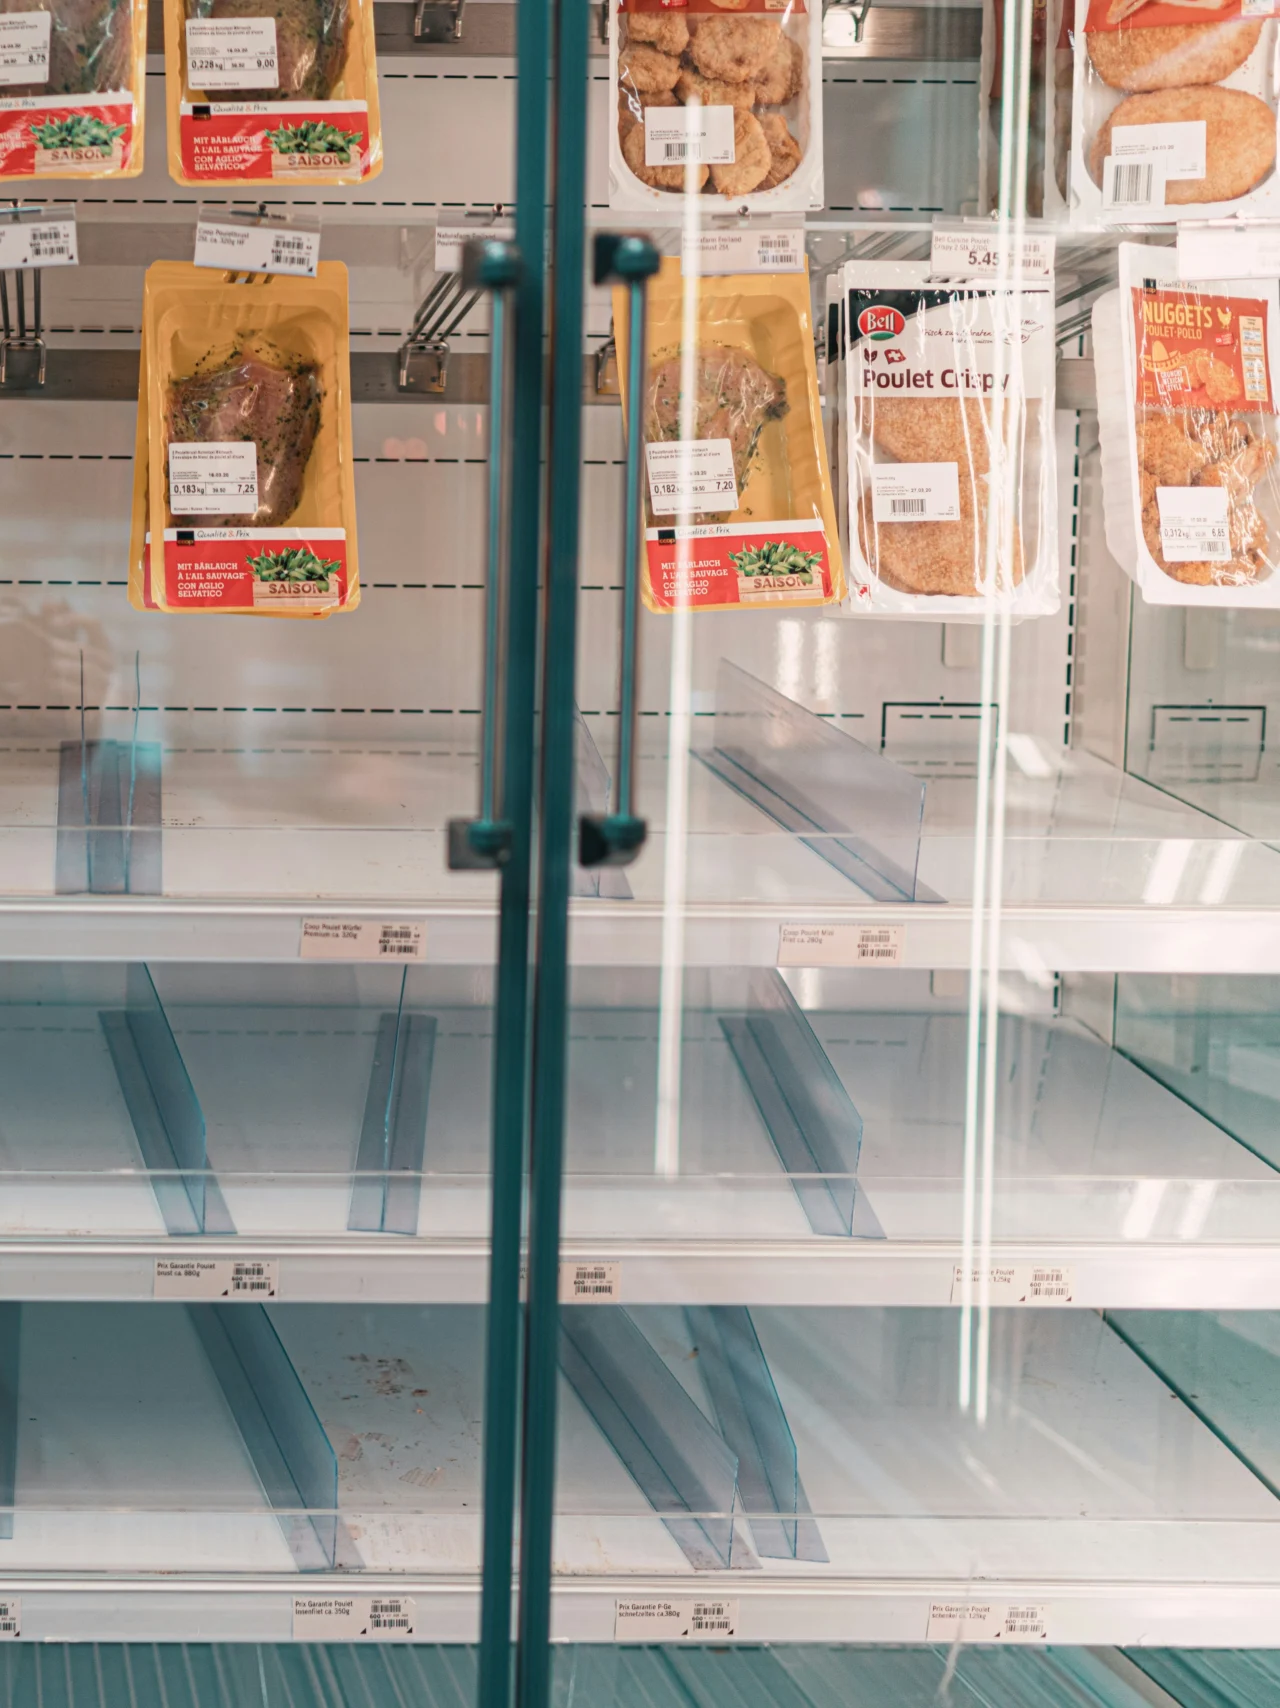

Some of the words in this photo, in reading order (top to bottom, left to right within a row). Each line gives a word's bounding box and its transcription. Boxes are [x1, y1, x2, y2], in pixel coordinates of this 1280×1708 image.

[191, 59, 214, 71] 0,228
[256, 58, 275, 69] 9,00
[253, 104, 268, 112] Prix
[193, 137, 209, 145] MIT
[51, 148, 106, 162] SAISON
[288, 153, 344, 166] SAISON
[947, 236, 969, 244] Cuisine
[934, 243, 952, 251] Crispy
[968, 251, 1000, 266] 5.45
[1142, 301, 1213, 328] NUGGETS
[867, 312, 895, 332] Bell
[863, 369, 934, 389] Poulet
[940, 369, 1010, 392] Crispy
[173, 484, 196, 495] 0,183
[197, 487, 205, 495] kg
[237, 484, 255, 495] 7,25
[654, 484, 676, 496] 0,182
[716, 480, 734, 491] 7,20
[197, 529, 227, 538] Qualité
[228, 530, 235, 538] &
[235, 529, 250, 538] Prix
[708, 526, 715, 534] &
[715, 525, 730, 534] Prix
[1163, 528, 1182, 538] 0,312
[177, 562, 193, 571] MIT
[194, 561, 238, 571] BÄRLAUCH
[661, 562, 676, 570] MIT
[178, 570, 184, 580] À
[185, 572, 204, 580] L'AIL
[206, 572, 245, 580] SAUVAGE
[662, 570, 668, 580] À
[690, 568, 728, 578] SAUVAGE
[178, 582, 196, 590] CON
[198, 581, 225, 590] AGLIO
[753, 577, 807, 589] SAISON
[178, 589, 223, 598] SELVATICO
[269, 583, 323, 594] SAISON
[342, 931, 357, 939] 320g
[334, 1608, 350, 1616] 350g
